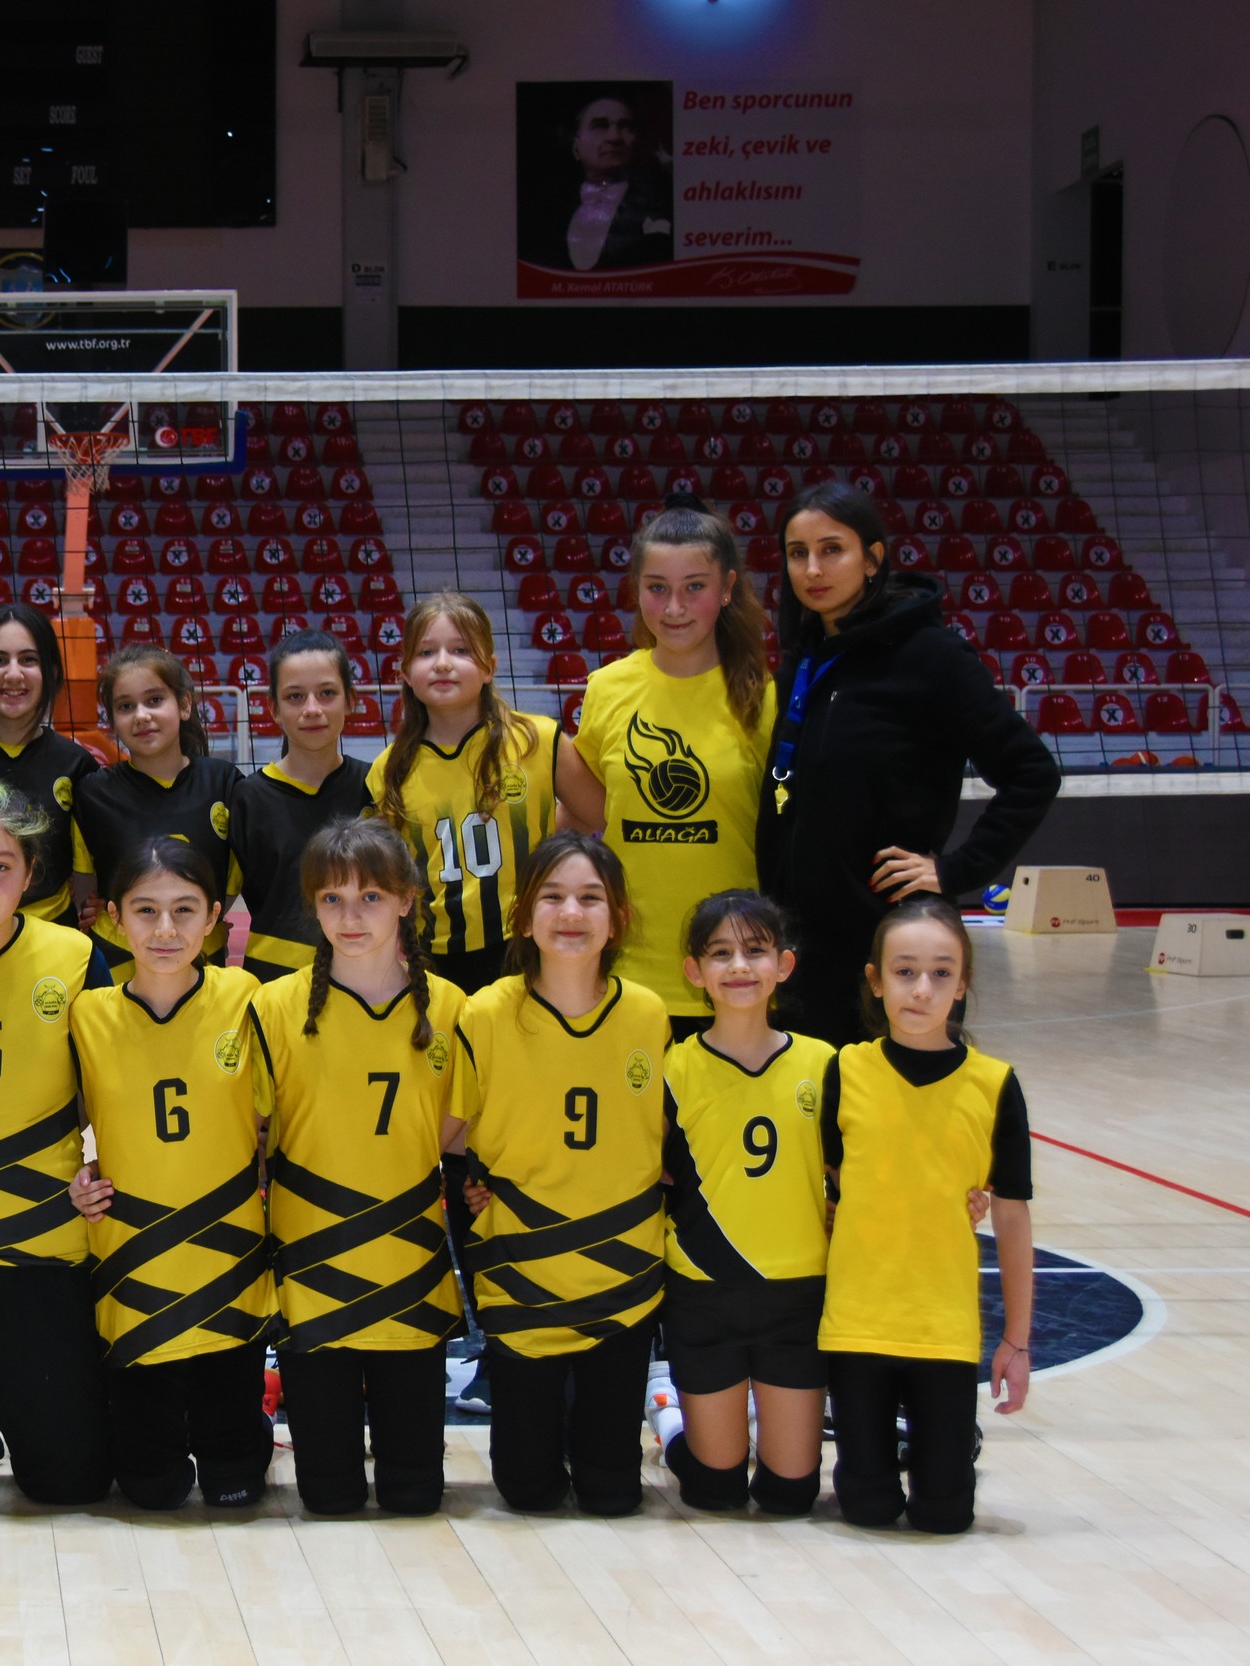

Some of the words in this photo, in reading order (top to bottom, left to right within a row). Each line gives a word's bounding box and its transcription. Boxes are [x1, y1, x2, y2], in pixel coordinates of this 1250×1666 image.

[76, 46, 103, 64] GUEST
[684, 91, 726, 110] Ben
[732, 92, 852, 115] sporcunun
[49, 105, 76, 124] SCORE
[683, 137, 735, 159] zeki,
[741, 135, 798, 160] çevik
[807, 139, 831, 154] ve
[13, 166, 31, 185] SET
[71, 166, 98, 184] FOUL
[684, 181, 803, 201] ahlaklısını
[684, 227, 792, 246] severim...
[1047, 261, 1056, 271] E
[551, 284, 564, 293] M.
[567, 282, 601, 292] Kemal
[602, 281, 652, 292] ATATÜRK
[46, 338, 131, 352] www.tbf.org.tr
[435, 812, 502, 883] 10
[1086, 874, 1100, 882] 40
[1187, 923, 1197, 933] 30
[153, 1078, 190, 1142] 6
[367, 1072, 400, 1136] 7
[564, 1087, 598, 1150] 9
[742, 1116, 778, 1179] 9
